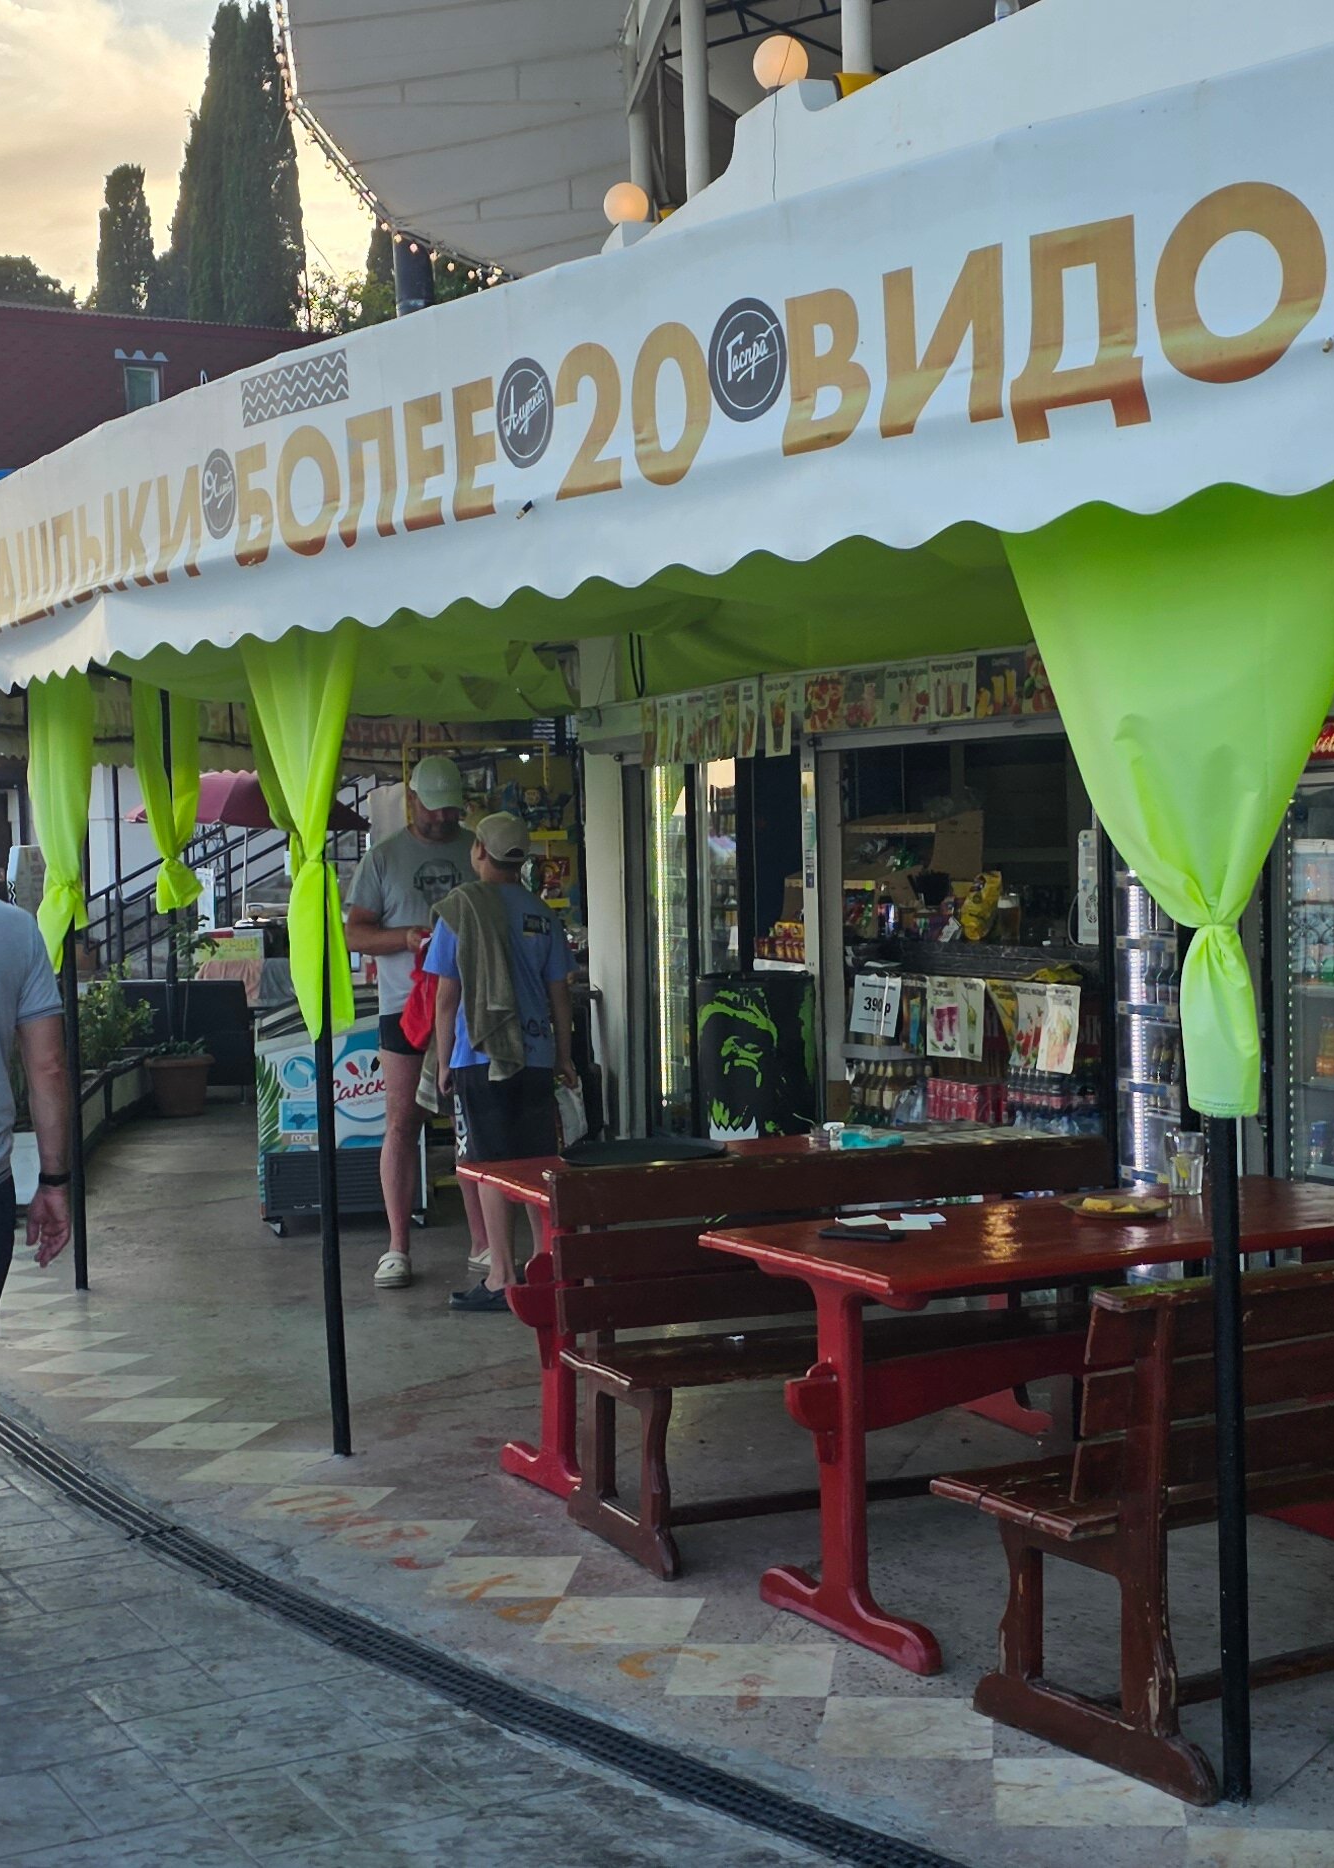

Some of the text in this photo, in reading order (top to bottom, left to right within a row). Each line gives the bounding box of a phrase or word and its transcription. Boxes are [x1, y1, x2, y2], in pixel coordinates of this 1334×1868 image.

[727, 331, 770, 382] Гаспра
[234, 376, 496, 567] БОЛЕЕ
[555, 321, 712, 500] 20
[290, 1134, 314, 1143] ГОСТ
